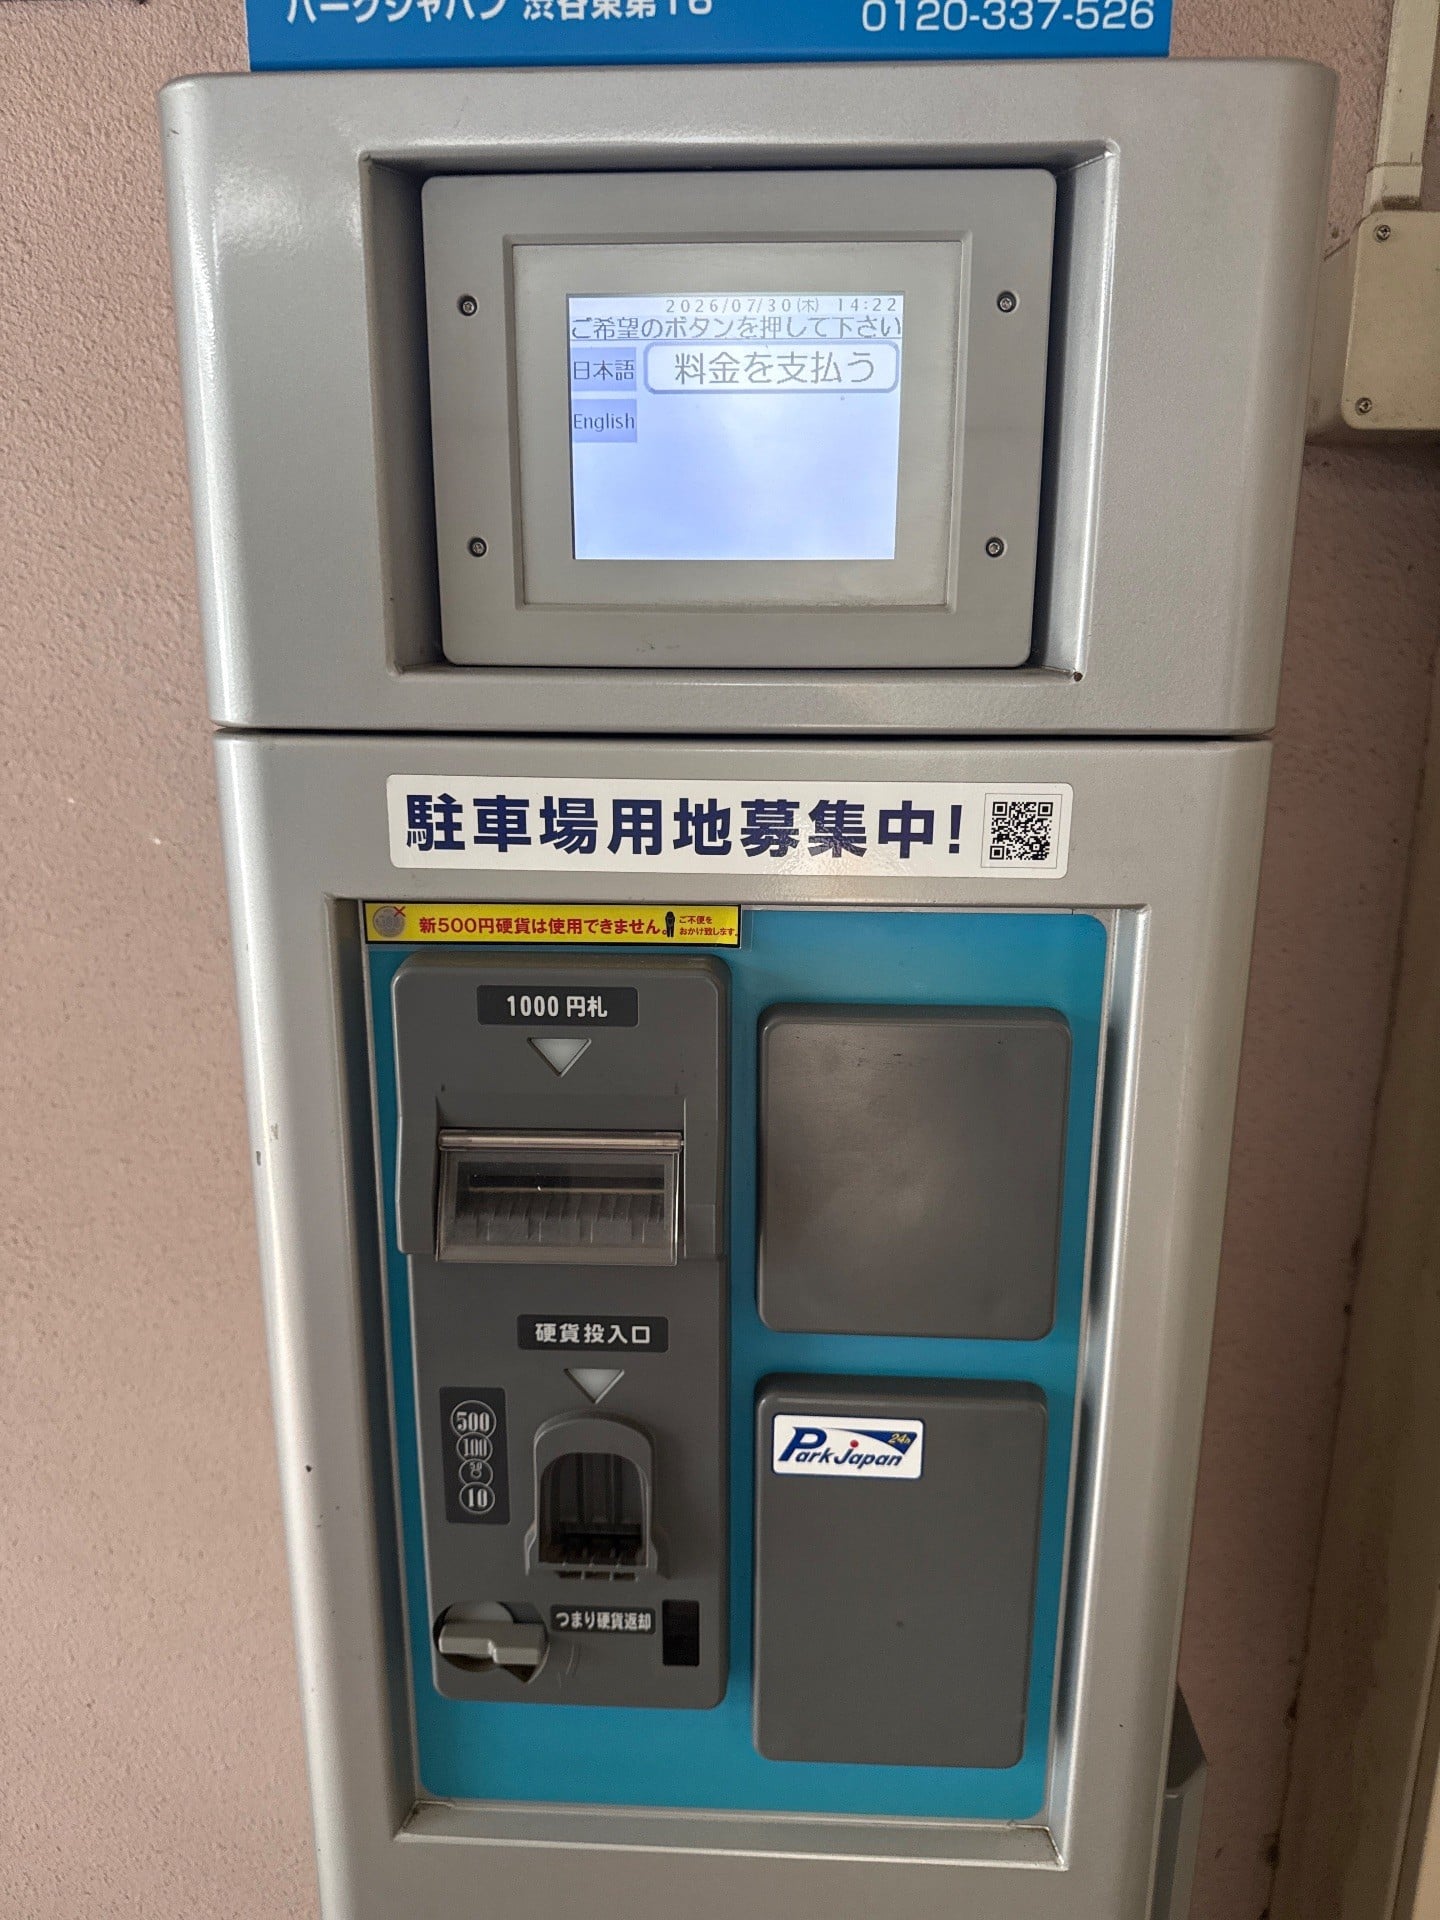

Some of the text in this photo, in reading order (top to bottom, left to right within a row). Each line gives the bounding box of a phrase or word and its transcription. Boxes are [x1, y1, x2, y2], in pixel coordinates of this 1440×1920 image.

[862, 0, 1155, 31] 0120-337-526
[838, 297, 897, 312] 14:22
[571, 315, 901, 340] ご希望のボタンを押して下さい
[573, 359, 635, 382] 日本語
[675, 351, 875, 385] 料金を支払う
[573, 412, 635, 432] English
[405, 793, 963, 859] 駐車場用地募集中!
[679, 915, 713, 925] ご不便を
[506, 995, 608, 1018] 1000 円札
[535, 1323, 651, 1344] 硬貨投入口
[456, 1411, 490, 1433] 500
[463, 1438, 488, 1458] 100
[778, 1427, 902, 1469] Park Japan
[468, 1488, 488, 1508] 10
[556, 1611, 652, 1630] つまり硬貨返却
